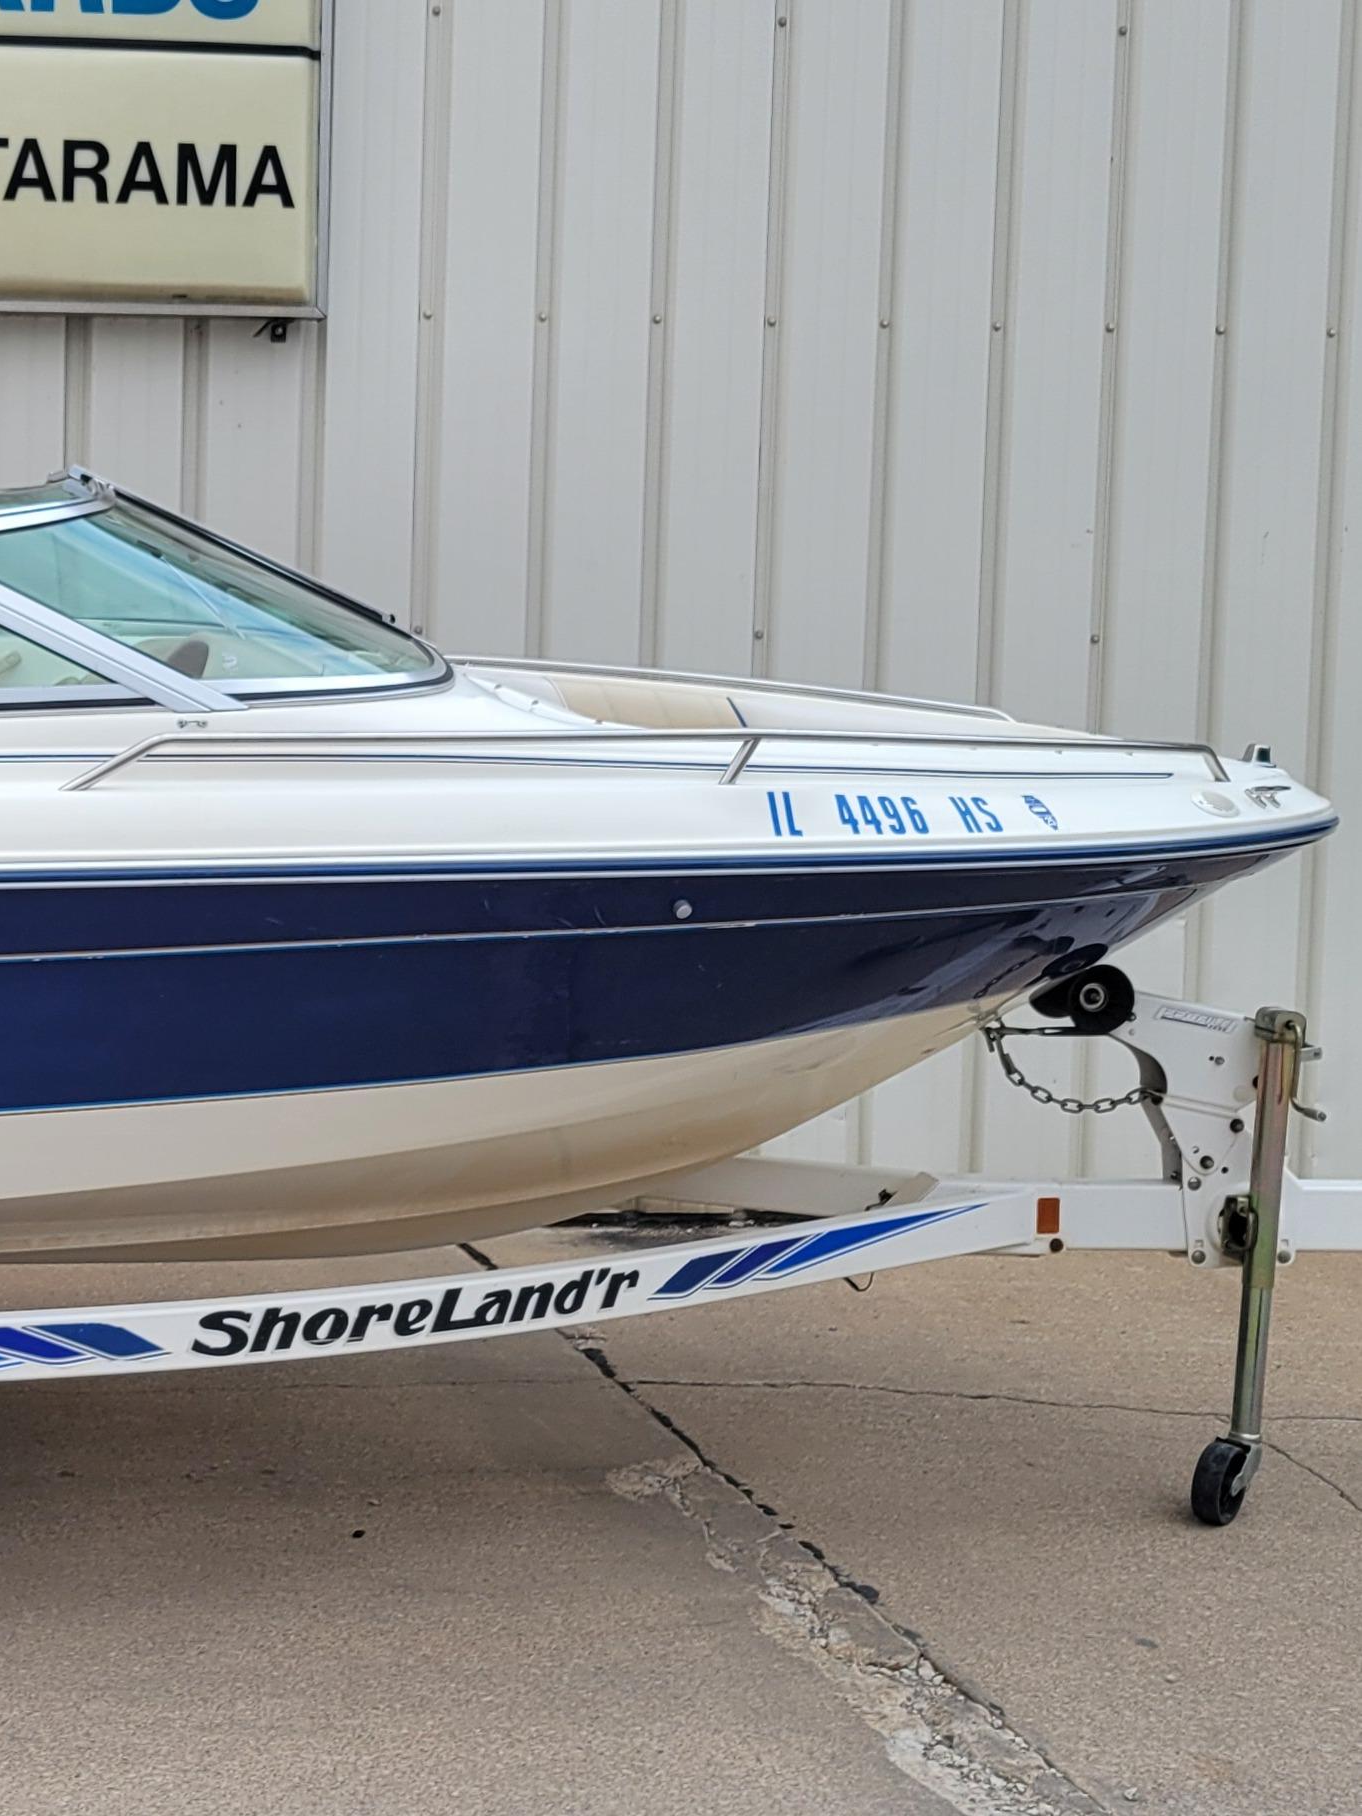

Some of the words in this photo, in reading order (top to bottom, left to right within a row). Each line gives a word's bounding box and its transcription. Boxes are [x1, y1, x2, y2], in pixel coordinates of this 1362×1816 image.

[766, 791, 804, 837] IL
[834, 794, 930, 835] 4496
[948, 796, 1004, 833] HS
[191, 1267, 640, 1357] ShoreLand'r
